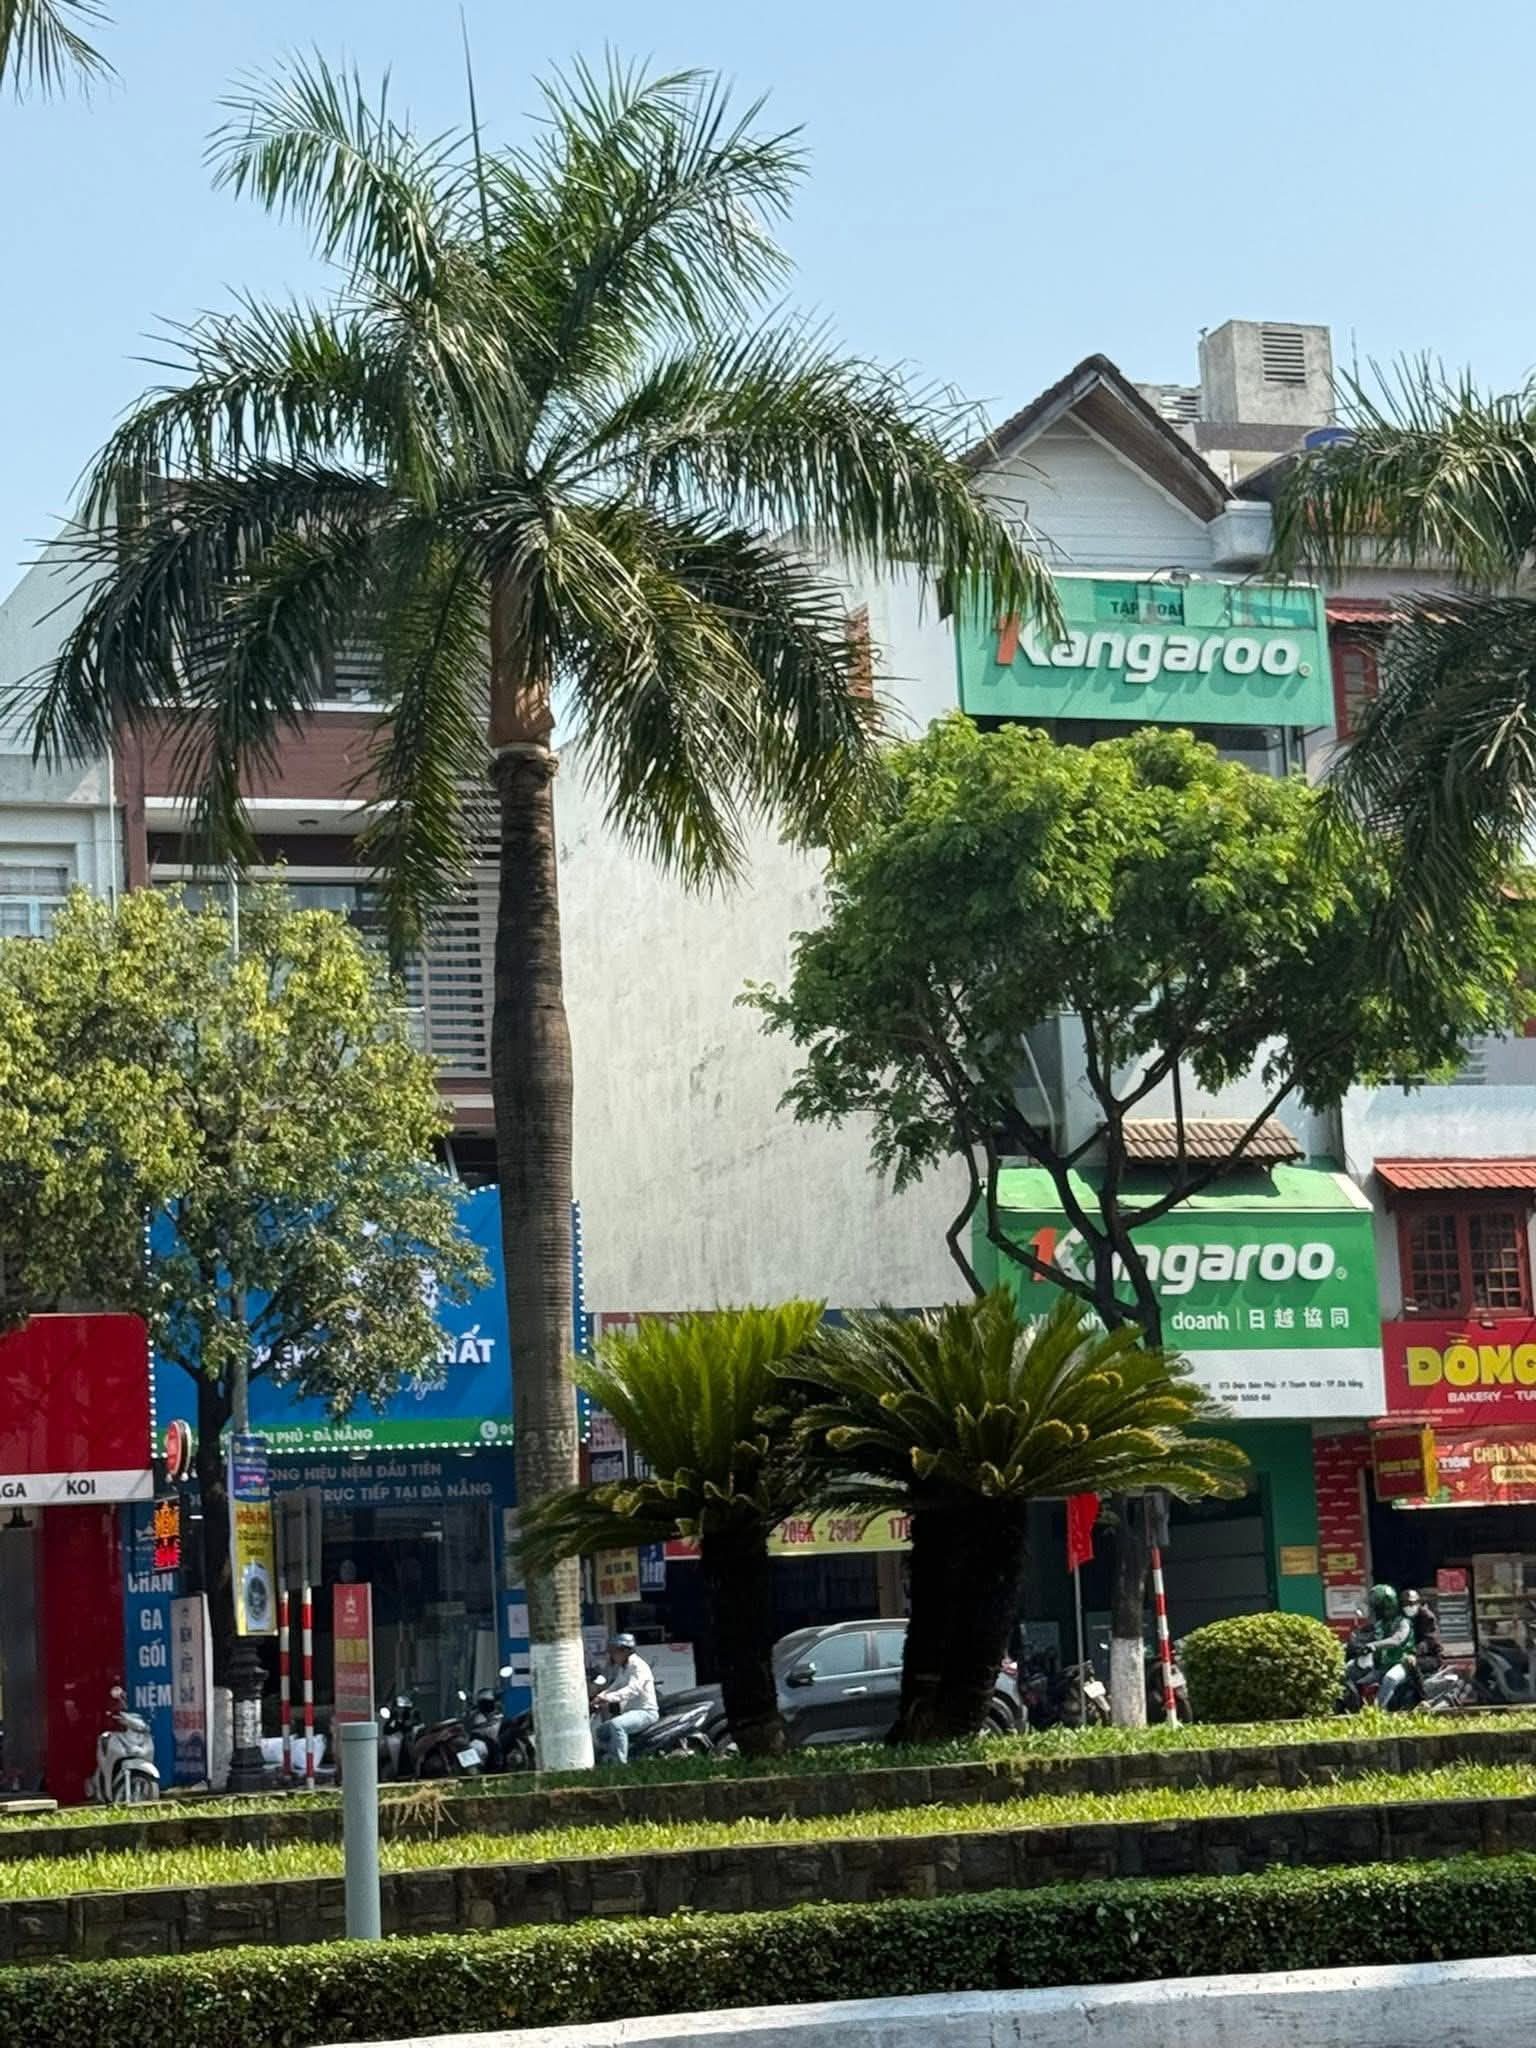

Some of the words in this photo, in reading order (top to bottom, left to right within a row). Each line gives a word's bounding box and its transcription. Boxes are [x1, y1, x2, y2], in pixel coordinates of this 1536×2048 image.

[996, 611, 1300, 683] Kangaroo
[1172, 1311, 1229, 1330] doanh
[1447, 1390, 1502, 1404] BAKERY
[275, 1427, 303, 1443] PHỦ
[333, 1424, 373, 1441] NẴNG
[304, 1461, 337, 1483] HIỆU
[0, 1482, 27, 1498] GA
[66, 1479, 97, 1496] KOI
[361, 1480, 391, 1501] TIẾP
[446, 1478, 493, 1497] NẴNG
[140, 1608, 163, 1631] GA
[138, 1638, 166, 1668] GỐI
[135, 1681, 173, 1714] NỆM
